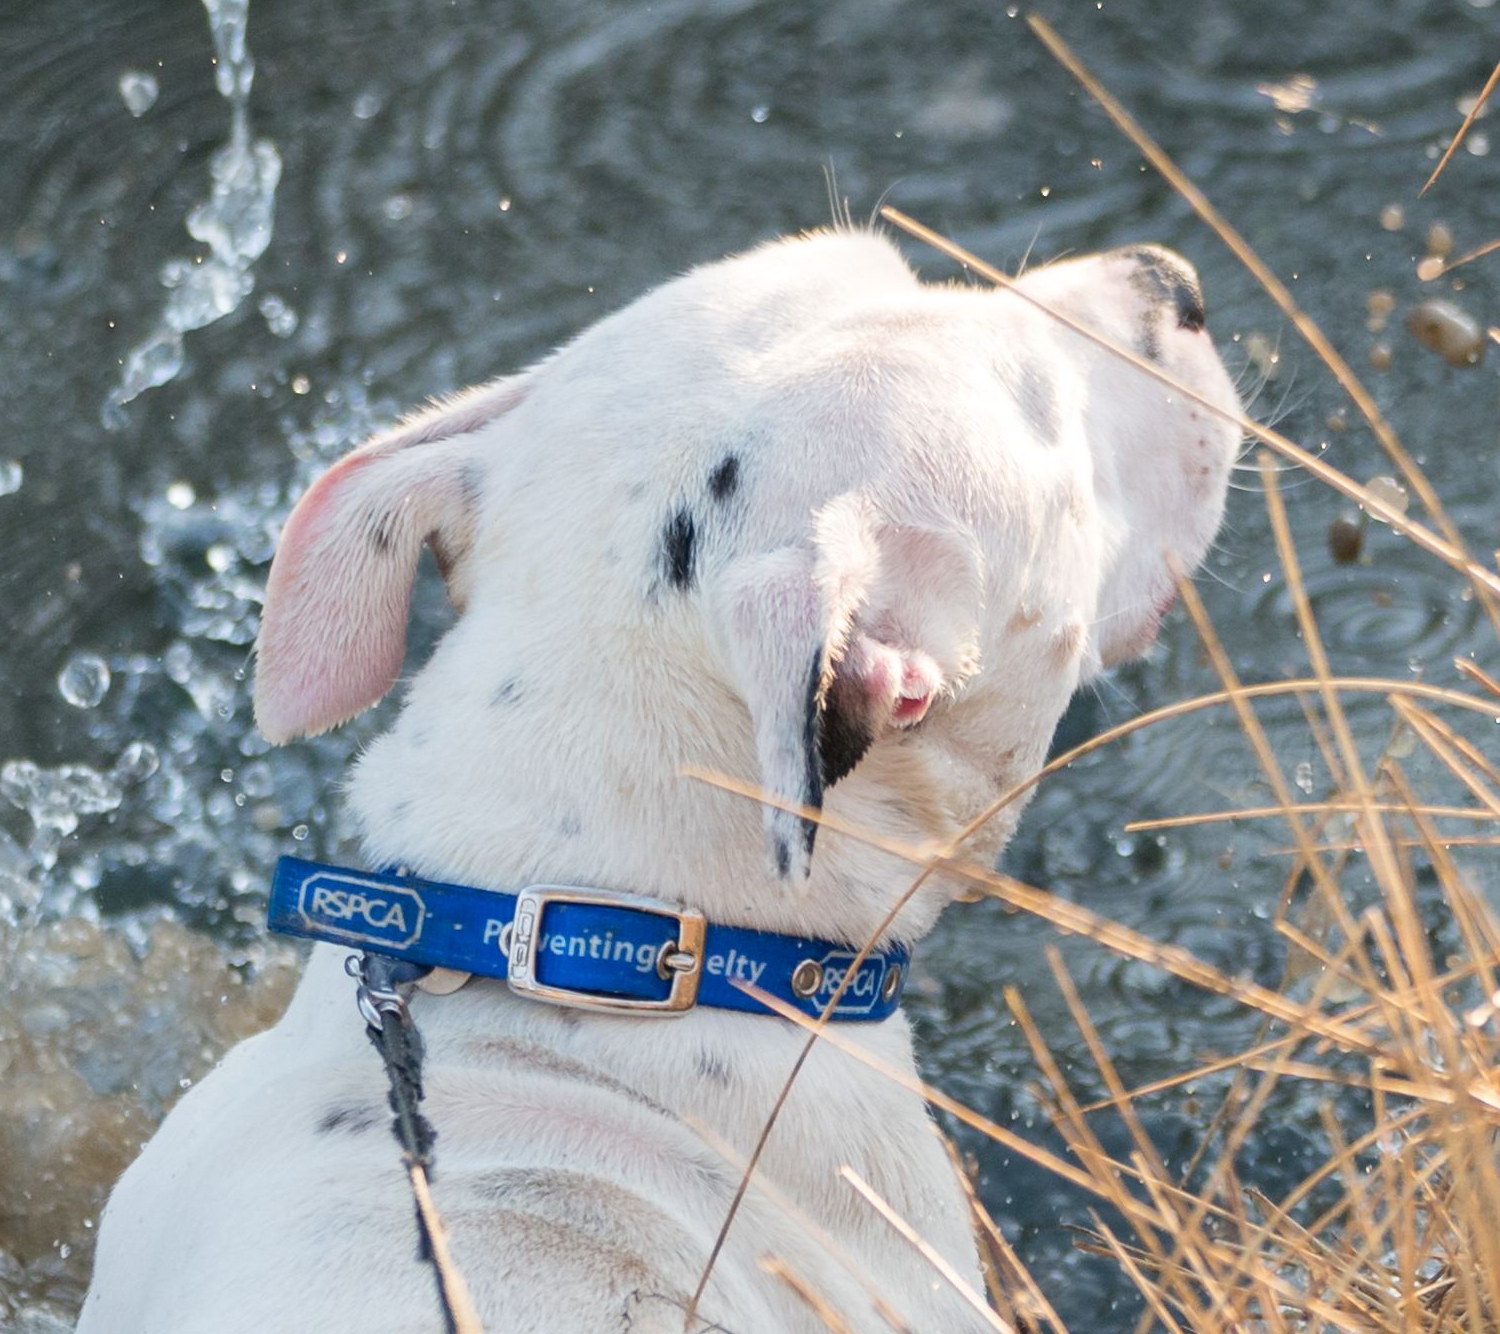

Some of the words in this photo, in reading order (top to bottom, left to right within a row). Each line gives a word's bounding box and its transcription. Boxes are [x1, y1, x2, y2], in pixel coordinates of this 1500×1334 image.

[311, 887, 407, 932] RSPCA
[482, 918, 657, 973] Pventing
[706, 949, 767, 985] elty
